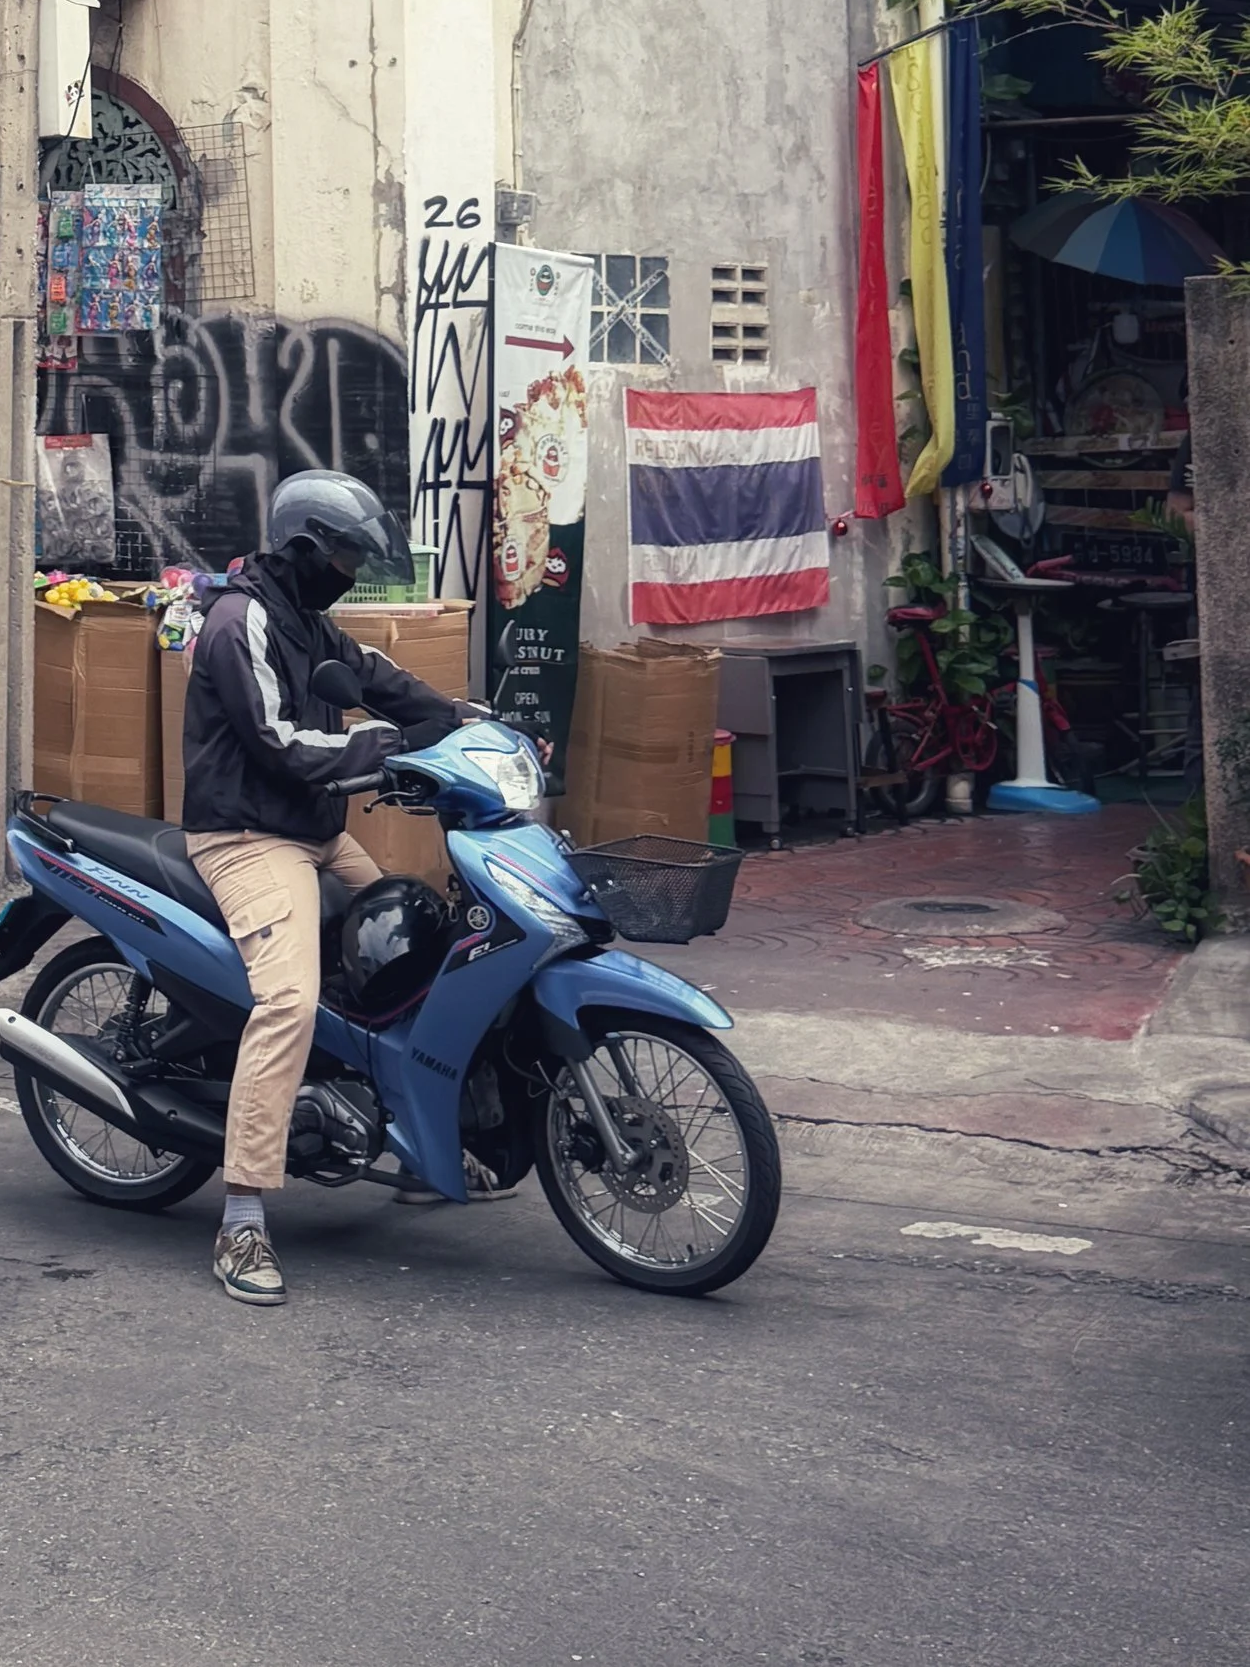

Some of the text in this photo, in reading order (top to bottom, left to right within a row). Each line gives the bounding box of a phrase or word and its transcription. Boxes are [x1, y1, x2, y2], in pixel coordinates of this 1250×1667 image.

[423, 195, 481, 229] 26
[515, 628, 549, 642] URY
[514, 692, 539, 706] OPEN
[411, 1046, 458, 1081] YAMAHA
